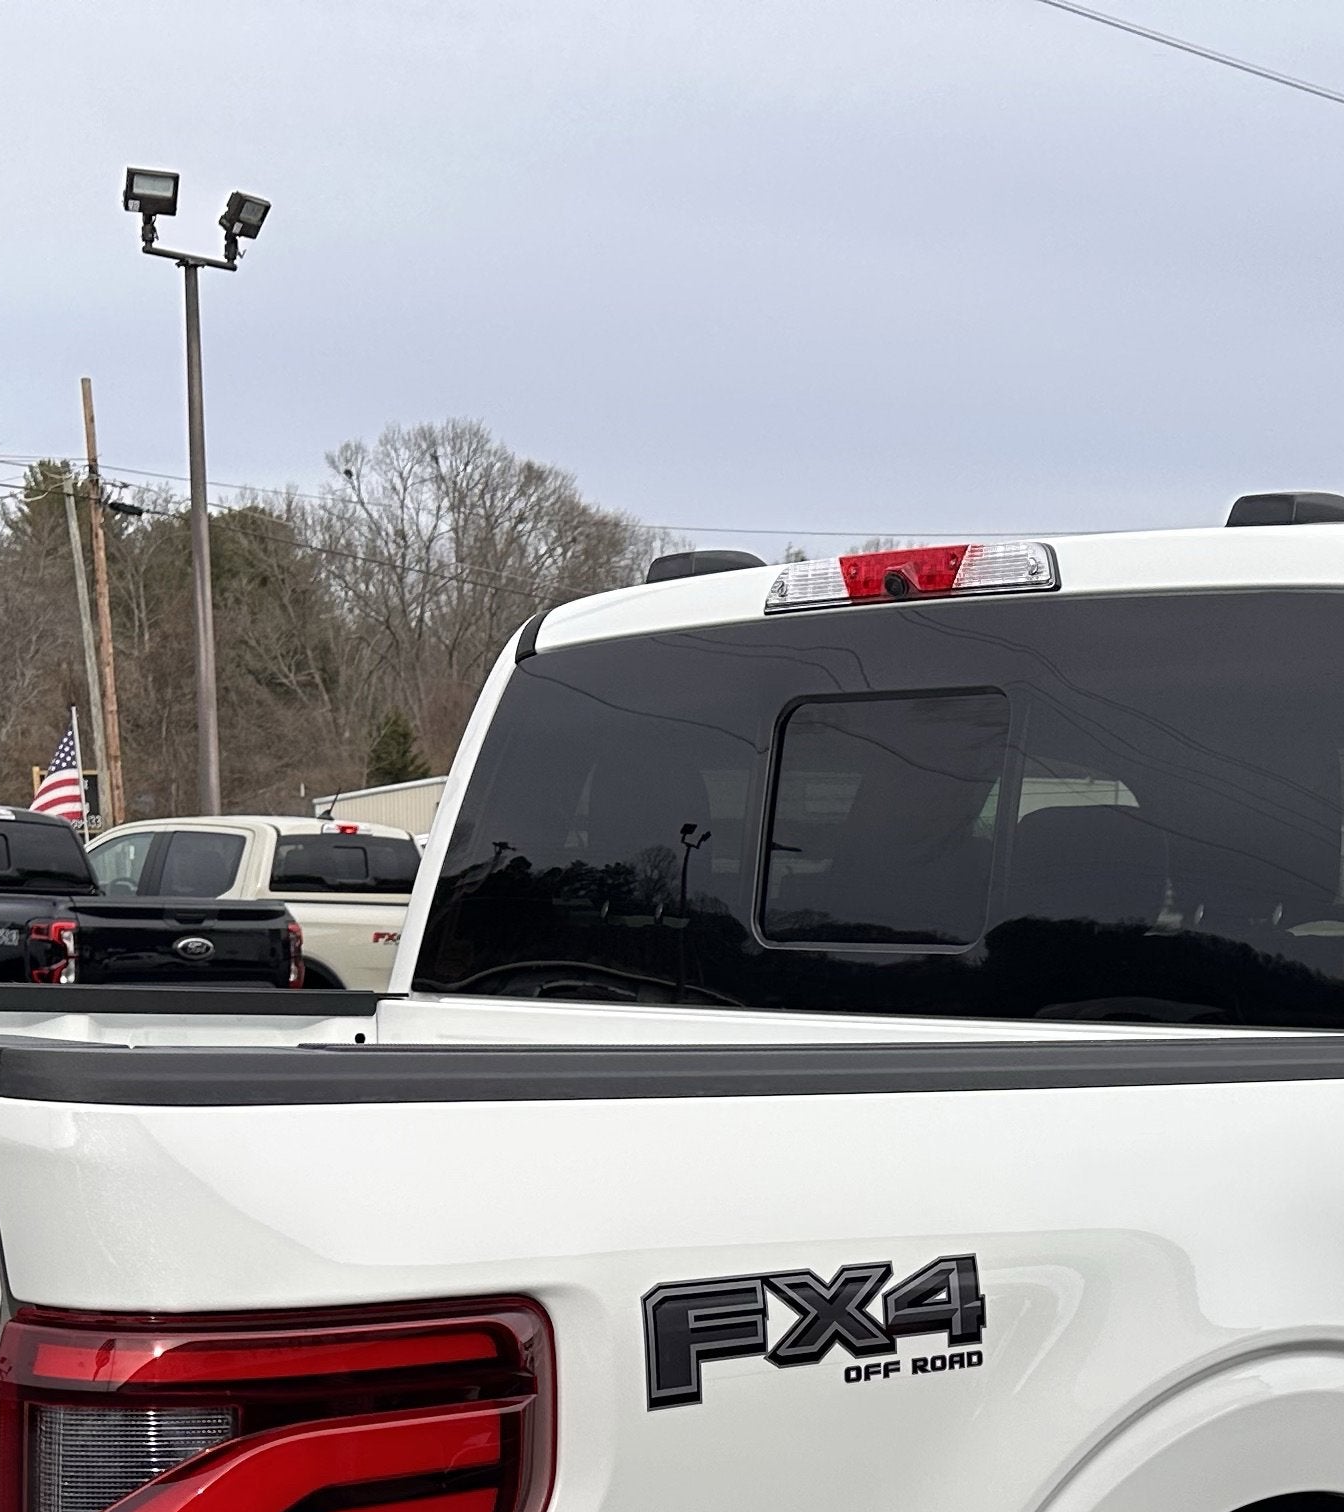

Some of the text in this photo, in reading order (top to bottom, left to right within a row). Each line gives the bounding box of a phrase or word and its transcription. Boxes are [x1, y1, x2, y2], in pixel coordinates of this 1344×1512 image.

[640, 1252, 986, 1412] FX4
[843, 1350, 984, 1385] OFF ROAD
